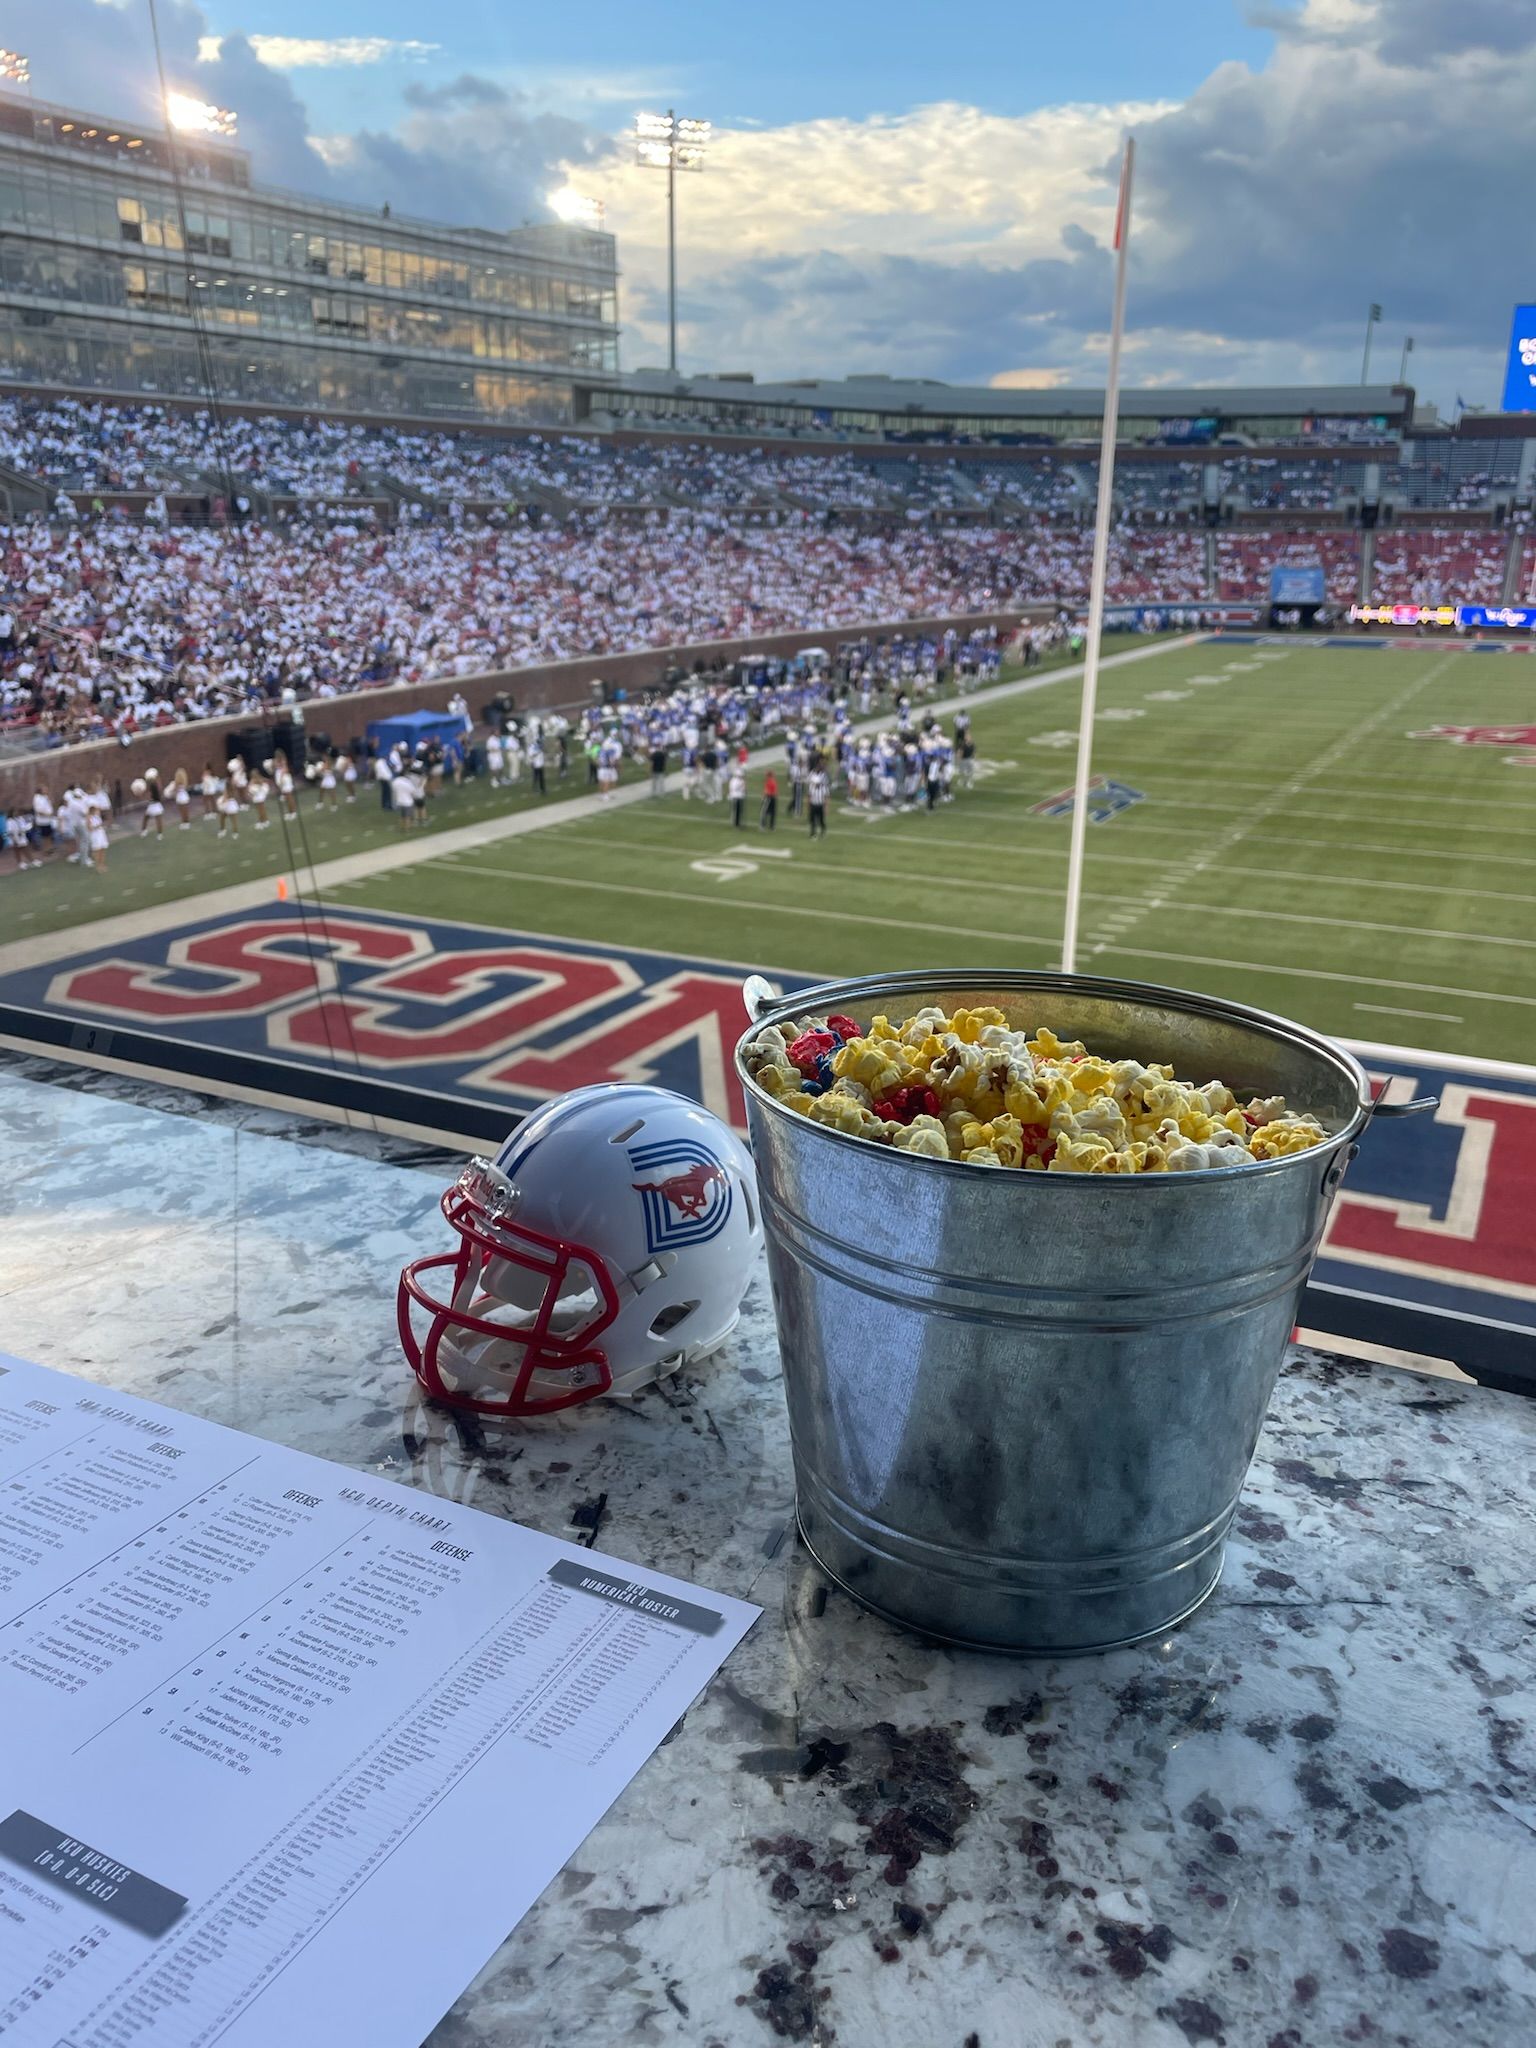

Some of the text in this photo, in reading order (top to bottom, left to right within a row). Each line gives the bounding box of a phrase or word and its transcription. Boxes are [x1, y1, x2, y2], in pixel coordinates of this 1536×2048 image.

[24, 1400, 61, 1416] OFFENSE
[100, 1407, 137, 1424] DEPTH
[136, 1419, 174, 1436] CHART
[147, 1442, 186, 1460] DEFENSE
[283, 1490, 323, 1508] OFFENSE
[338, 1488, 452, 1531] HCU DEPTH CHART
[430, 1541, 474, 1562] DEFENSE
[580, 1578, 680, 1618] NUMERICAL ROSTER
[625, 1583, 649, 1597] HCU
[237, 1700, 251, 1711] King
[195, 1734, 210, 1744] King
[57, 1838, 131, 1883] HCU HUSKIES
[65, 1867, 90, 1886] 0-0
[85, 1938, 100, 1949] PM
[74, 1948, 89, 1959] PM
